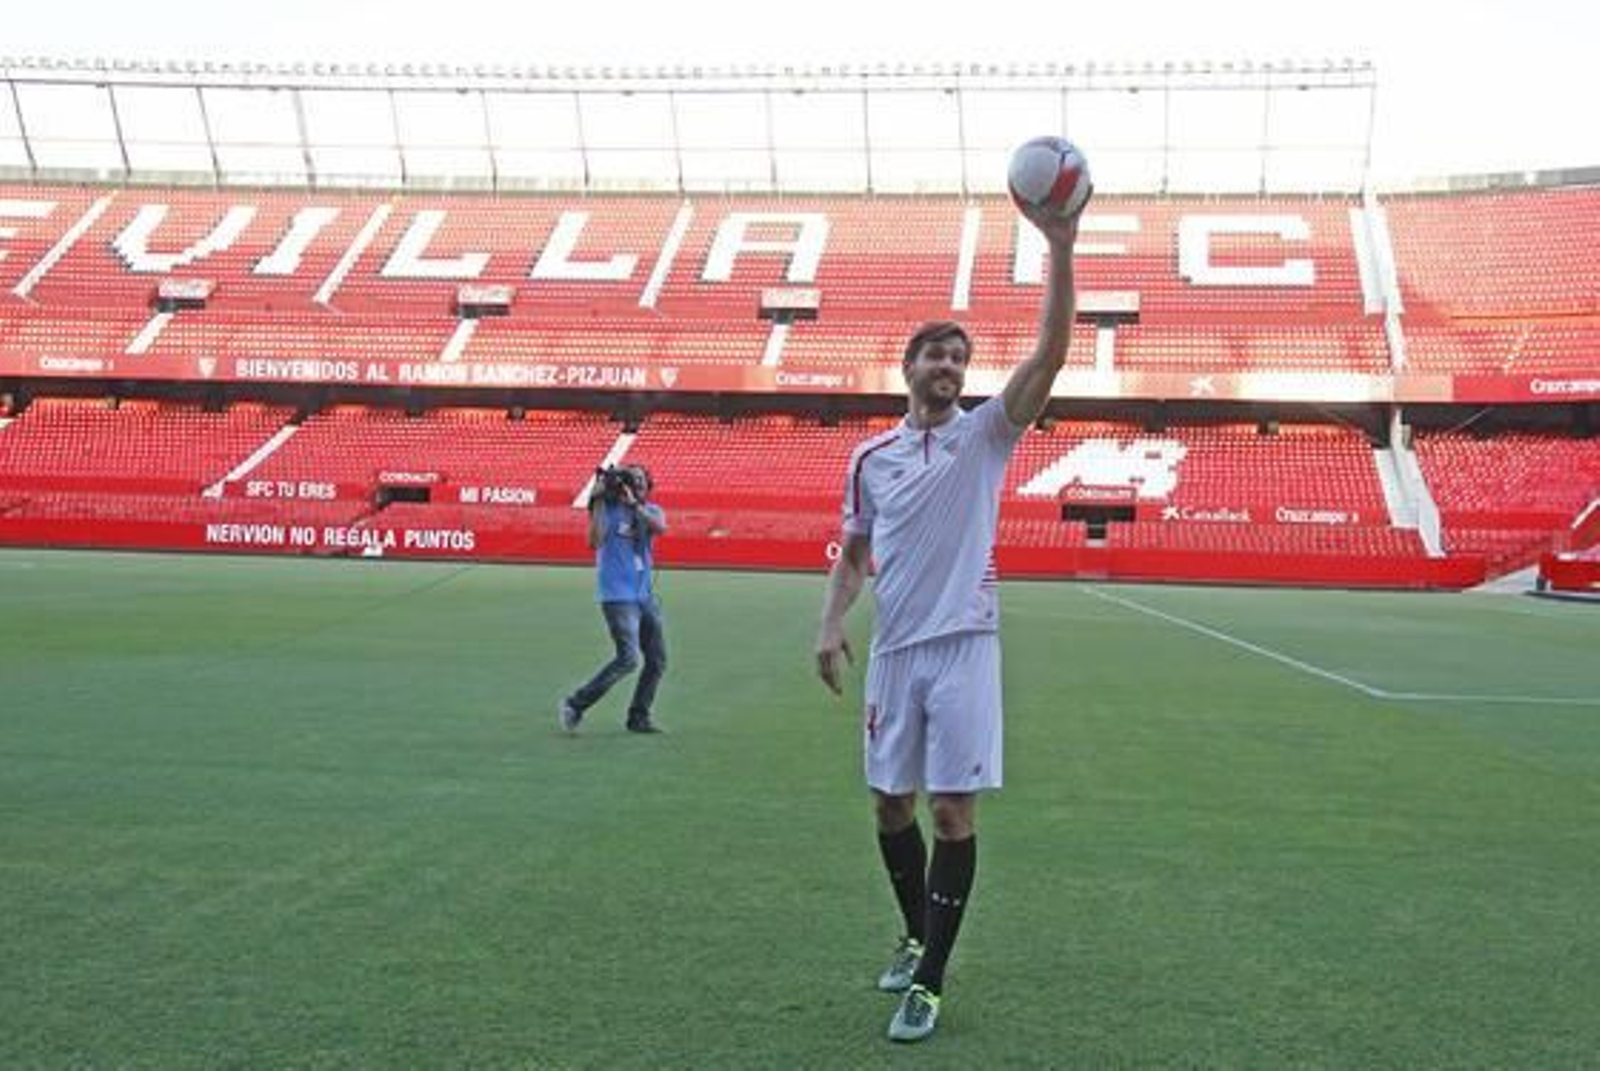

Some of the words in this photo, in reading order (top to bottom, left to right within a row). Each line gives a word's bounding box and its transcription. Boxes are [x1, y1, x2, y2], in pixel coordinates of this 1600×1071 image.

[1012, 214, 1316, 288] FC
[236, 358, 359, 382] BIENVENIDOS
[366, 363, 390, 381] AL
[246, 480, 274, 498] SFC
[206, 523, 284, 546] NERVION
[290, 526, 315, 546] NO
[323, 527, 396, 549] REGALA
[404, 529, 476, 550] PUNTOS
